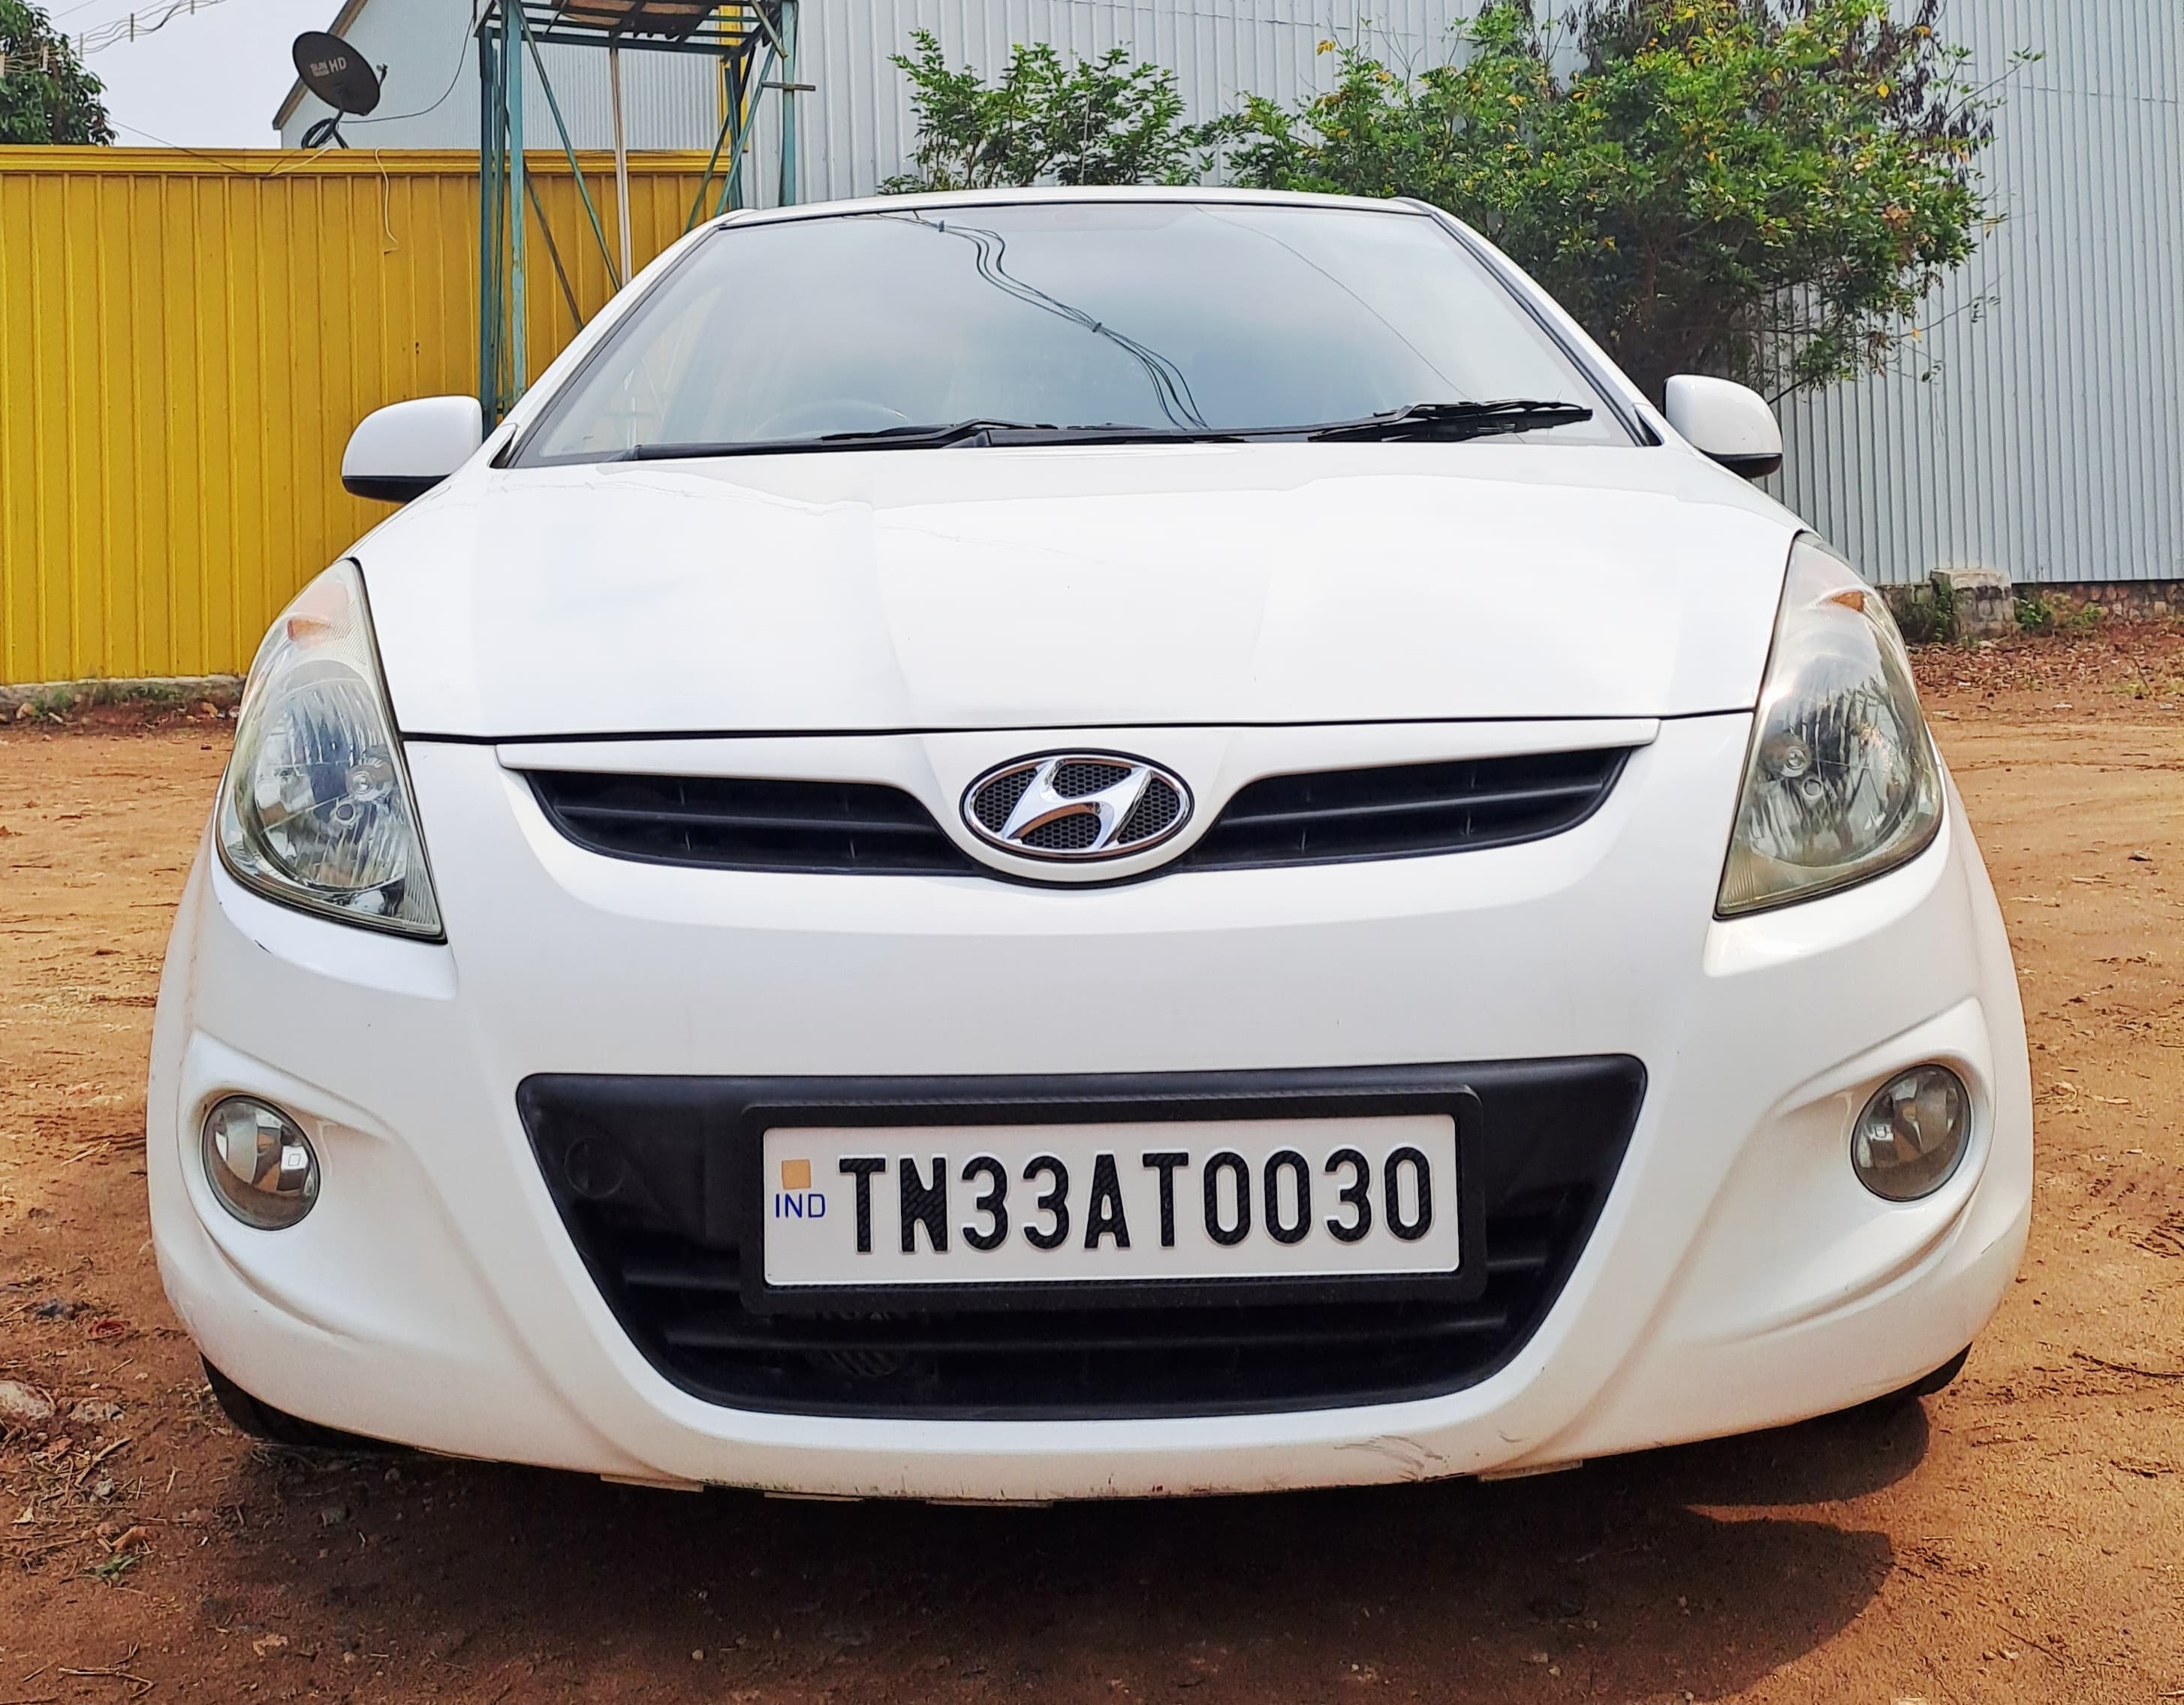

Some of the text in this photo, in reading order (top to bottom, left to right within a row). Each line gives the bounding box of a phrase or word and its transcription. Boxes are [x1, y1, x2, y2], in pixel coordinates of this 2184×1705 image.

[328, 57, 347, 72] HD
[775, 1193, 826, 1219] IND
[838, 1146, 1433, 1253] TN33AT0030
